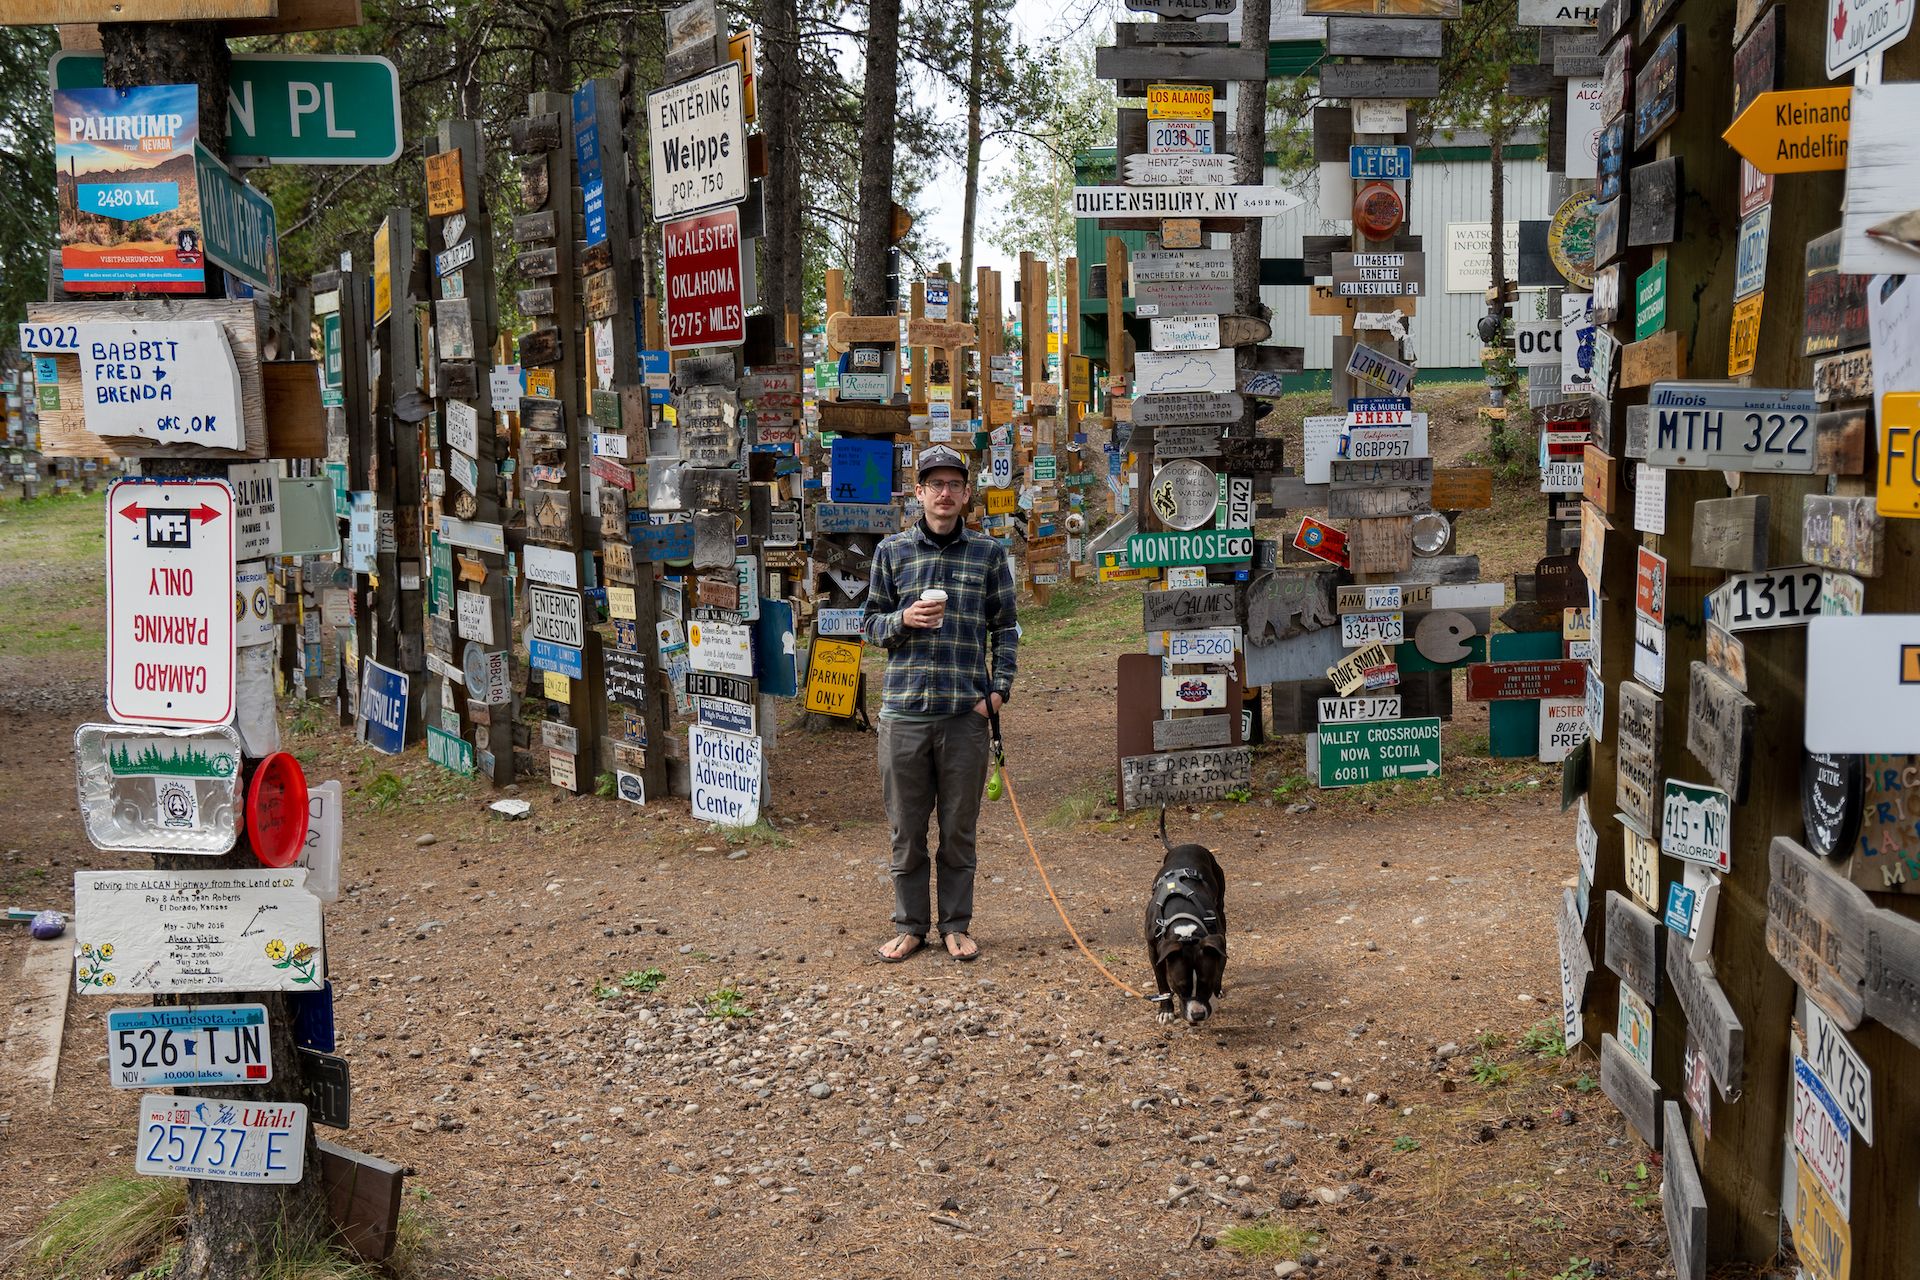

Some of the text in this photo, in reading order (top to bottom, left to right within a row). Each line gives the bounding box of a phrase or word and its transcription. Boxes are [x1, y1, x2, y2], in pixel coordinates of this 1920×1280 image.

[1848, 4, 1889, 49] July 2005
[662, 85, 730, 128] ENTERING
[1150, 92, 1211, 104] LOS ALAMOS
[288, 81, 356, 138] PL
[69, 113, 183, 143] PAHRUMP
[123, 138, 172, 153] true NEVADA
[1156, 129, 1211, 147] 2038 DE
[663, 133, 730, 174] Weippe
[1147, 158, 1224, 168] HENTZ SWAIN
[1357, 156, 1404, 176] LEIGH
[672, 173, 724, 201] POP. 750
[1143, 174, 1224, 183] OHIO IND
[97, 190, 159, 208] 2480 MI.
[1076, 191, 1209, 212] QUEENSBURY,
[1215, 191, 1239, 211] NY
[200, 162, 266, 274] PALO VERDE
[668, 224, 736, 258] McALESTER
[1151, 252, 1184, 260] WISEMAN
[1353, 255, 1404, 267] JIM&BETTY
[671, 267, 735, 300] OKLAHOMA
[1360, 269, 1400, 281] ARNETTE
[1341, 283, 1419, 295] GAINESVILLE FL
[671, 305, 740, 339] 2975 MILES
[24, 327, 80, 348] 2022
[92, 341, 179, 362] BABBIT
[95, 364, 142, 381] FRED
[846, 376, 885, 393] Rosthern
[97, 384, 172, 404] BRENDA
[1657, 390, 1707, 407] Illinois
[1353, 402, 1406, 412] JEFF & MURIEL
[1745, 402, 1811, 411] Land of Lincoln
[1355, 411, 1404, 424] EMERY
[1363, 430, 1399, 440] California
[1658, 411, 1809, 454] MTH 322
[1165, 438, 1196, 446] MARTIN
[1355, 440, 1409, 458] 8GBP957
[994, 459, 1010, 478] 99
[1165, 467, 1208, 478] GOODCHILD
[1333, 460, 1431, 483] LAC LA BICHE
[1175, 477, 1207, 487] POWELL
[1545, 475, 1580, 487] TOLEDO
[238, 478, 273, 506] SLOMAN
[1179, 489, 1213, 498] WATSON
[819, 505, 839, 518] Bob
[1186, 500, 1210, 508] CODY
[873, 519, 891, 529] USA
[1131, 534, 1253, 564] MONTROSE CO
[530, 563, 571, 583] Coopersville
[149, 568, 194, 597] ONLY
[1173, 591, 1233, 618] CALMES
[1339, 587, 1431, 607] ANN WILF
[1734, 572, 1823, 622] 1312
[535, 593, 577, 620] ENTERING
[821, 617, 840, 631] 200
[1356, 614, 1390, 624] Arkansas
[134, 614, 209, 646] PARKING
[536, 616, 577, 642] SIKESTON
[1346, 621, 1401, 640] 334 VCS
[537, 644, 551, 654] CITY
[1172, 639, 1232, 655] EB 5260
[1331, 644, 1385, 690] DAVE SMITH
[135, 662, 207, 694] CAMARO
[811, 669, 855, 687] PARKING
[816, 689, 845, 707] ONLY
[1177, 689, 1212, 697] CANADA
[1323, 702, 1357, 720] WAF
[1320, 726, 1439, 745] VALLEY CROSSROADS
[1556, 722, 1577, 733] BOB
[695, 733, 753, 765] Portside
[1341, 745, 1420, 761] NOVA SCOTIA
[1127, 760, 1157, 774] THE
[1383, 765, 1398, 778] KM
[695, 762, 757, 795] Adventure
[695, 788, 743, 818] Center
[1665, 803, 1727, 848] 415 NSY
[1677, 842, 1718, 861] COLORADO
[93, 878, 281, 894] Driving the ALCAN Highway from the Land of
[145, 893, 241, 904] Ray Jean Roberts
[160, 903, 228, 913] El Dorado, Kansas
[164, 922, 177, 932] May
[151, 1012, 245, 1027] Minnesota.com
[119, 1026, 261, 1069] 526 TJN
[122, 1071, 139, 1083] NOV
[164, 1070, 223, 1080] 10,000 lakes
[1817, 1016, 1867, 1128] XK 733
[213, 1105, 296, 1128] Ski Utah!
[146, 1124, 289, 1170] 25737 E
[175, 1166, 204, 1174] GREATEST
[208, 1168, 227, 1176] SNOW
